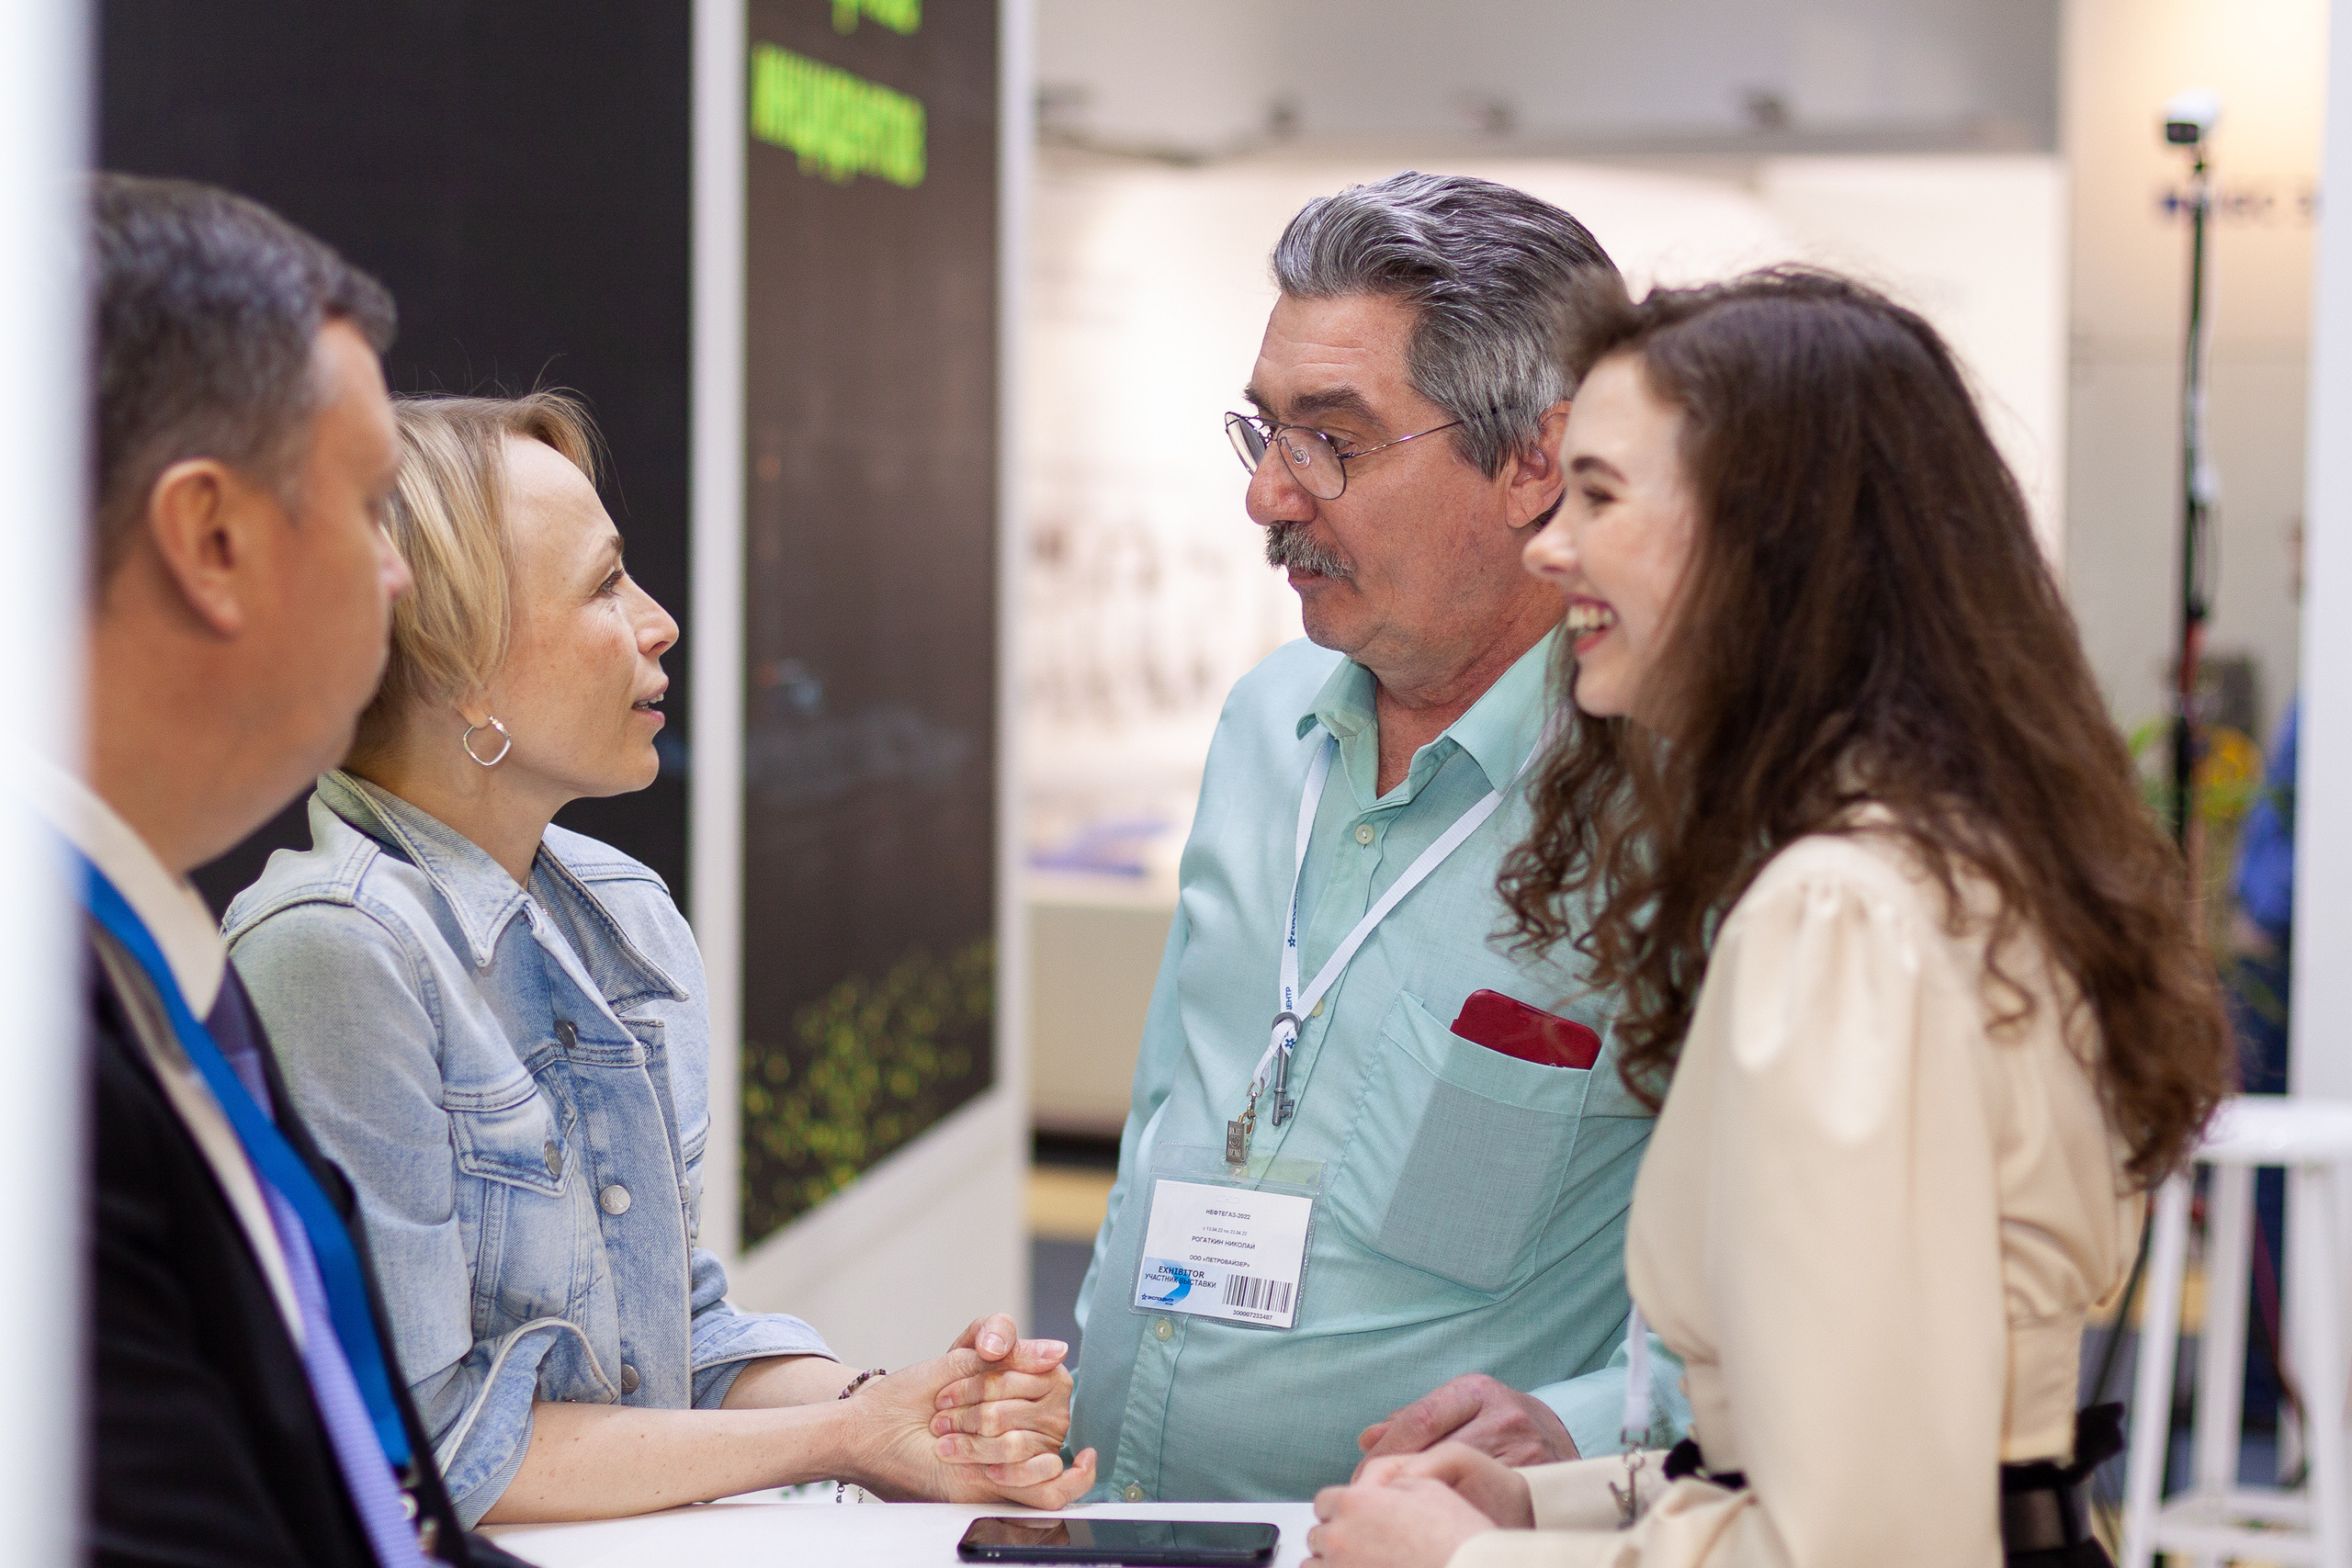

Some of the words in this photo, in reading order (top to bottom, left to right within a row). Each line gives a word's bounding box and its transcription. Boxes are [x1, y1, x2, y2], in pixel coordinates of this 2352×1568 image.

[1205, 1209, 1250, 1220] НЕФТЕГАЗ-2022
[1192, 1235, 1224, 1246] РОГАТКИН
[1225, 1239, 1256, 1249] НИКОЛАЙ
[1159, 1266, 1204, 1279] EXHIBITOR
[1145, 1273, 1178, 1283] УЧАСТНИК
[1179, 1278, 1216, 1289] ВЫСТАВКИ
